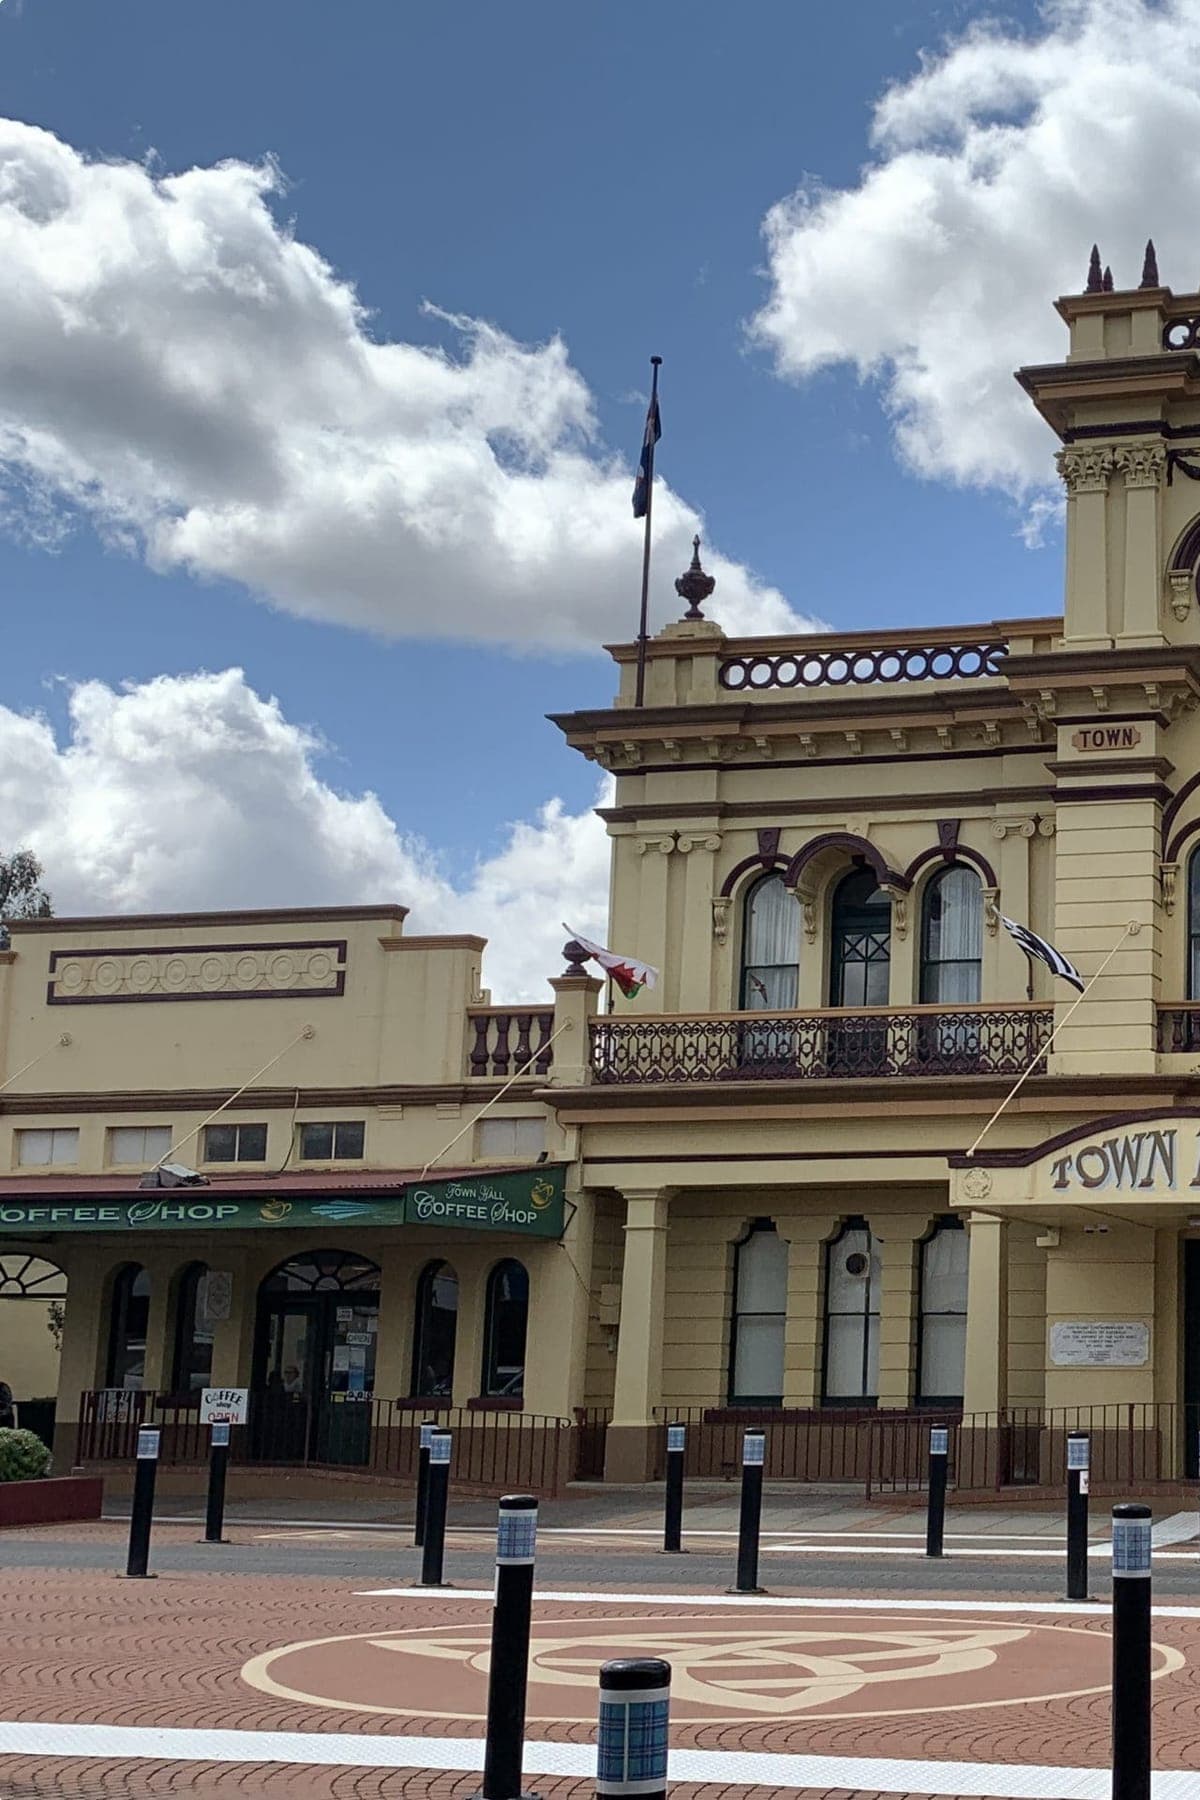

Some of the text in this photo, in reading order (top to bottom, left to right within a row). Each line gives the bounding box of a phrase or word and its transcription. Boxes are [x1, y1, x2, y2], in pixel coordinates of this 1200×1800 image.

[1079, 728, 1134, 748] TOWN
[1050, 1129, 1177, 1189] TOWN
[445, 1183, 505, 1201] TOWN HALL
[0, 1201, 240, 1227] OFFEE SHOP
[413, 1190, 538, 1225] COFFEE SHOP
